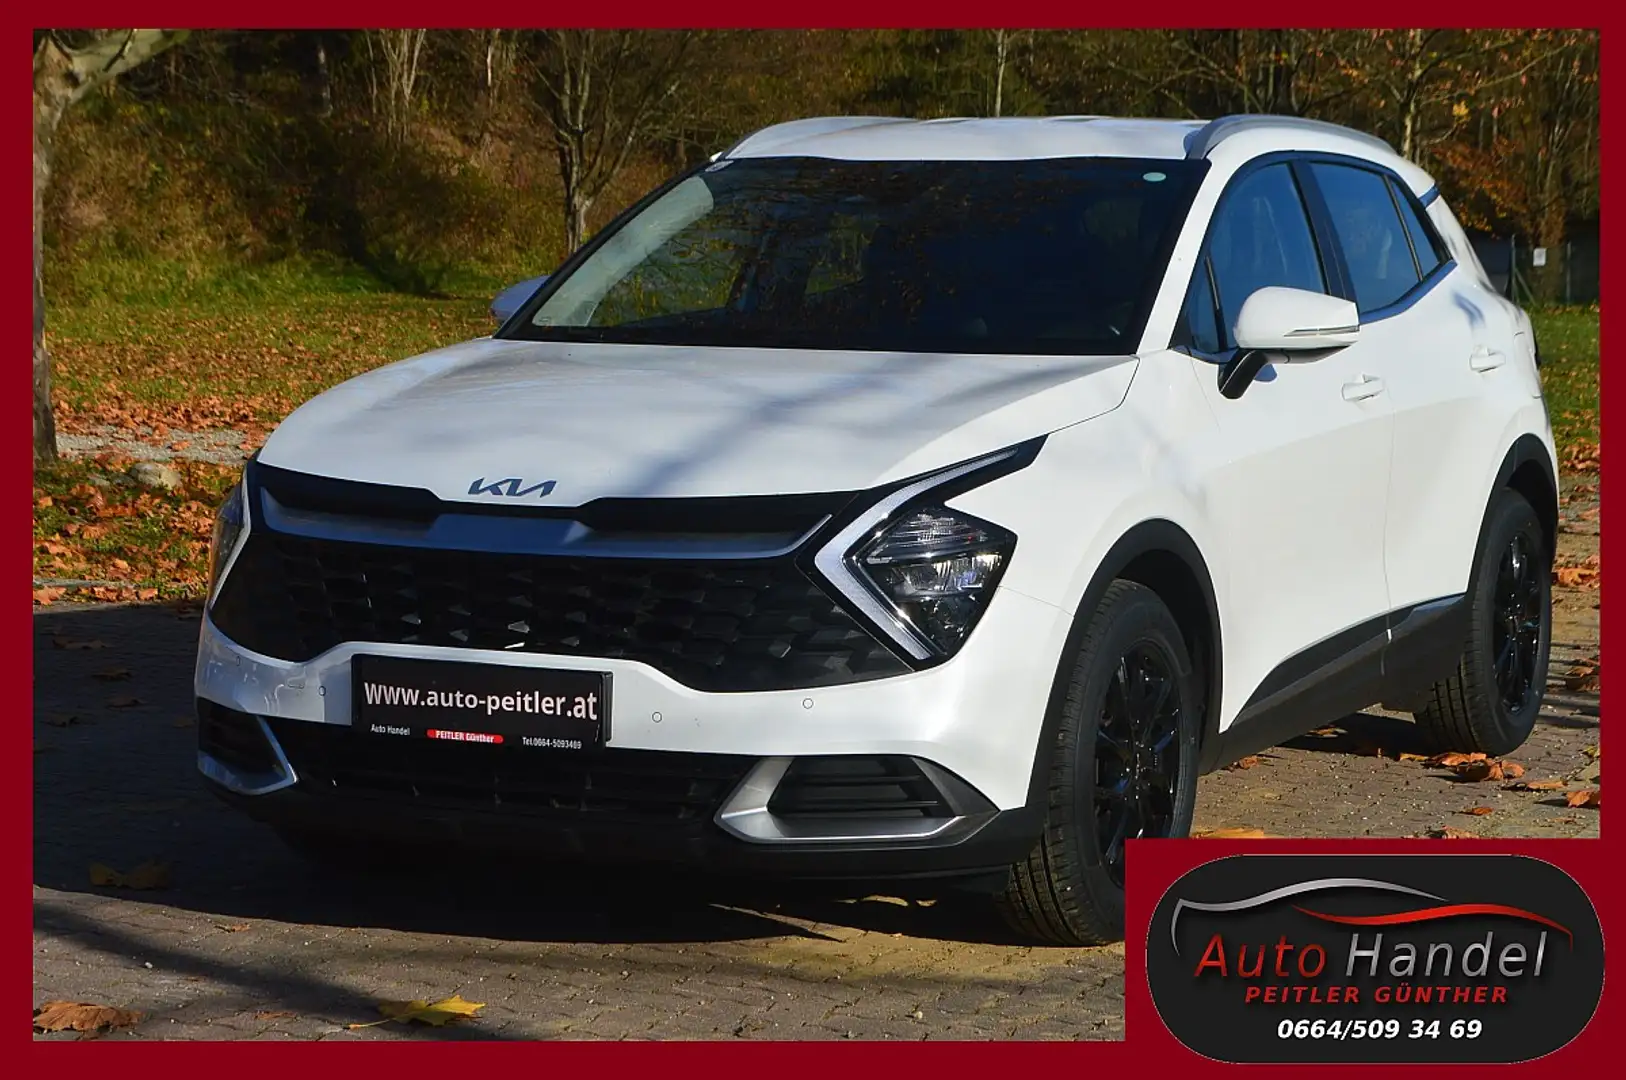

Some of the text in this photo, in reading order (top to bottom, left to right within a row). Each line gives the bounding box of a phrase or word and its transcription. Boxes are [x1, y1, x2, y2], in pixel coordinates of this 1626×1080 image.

[467, 477, 557, 498] KIA
[370, 723, 386, 734] Auto
[387, 725, 411, 736] Handel
[435, 730, 465, 741] PEITLER
[465, 732, 495, 744] Günther
